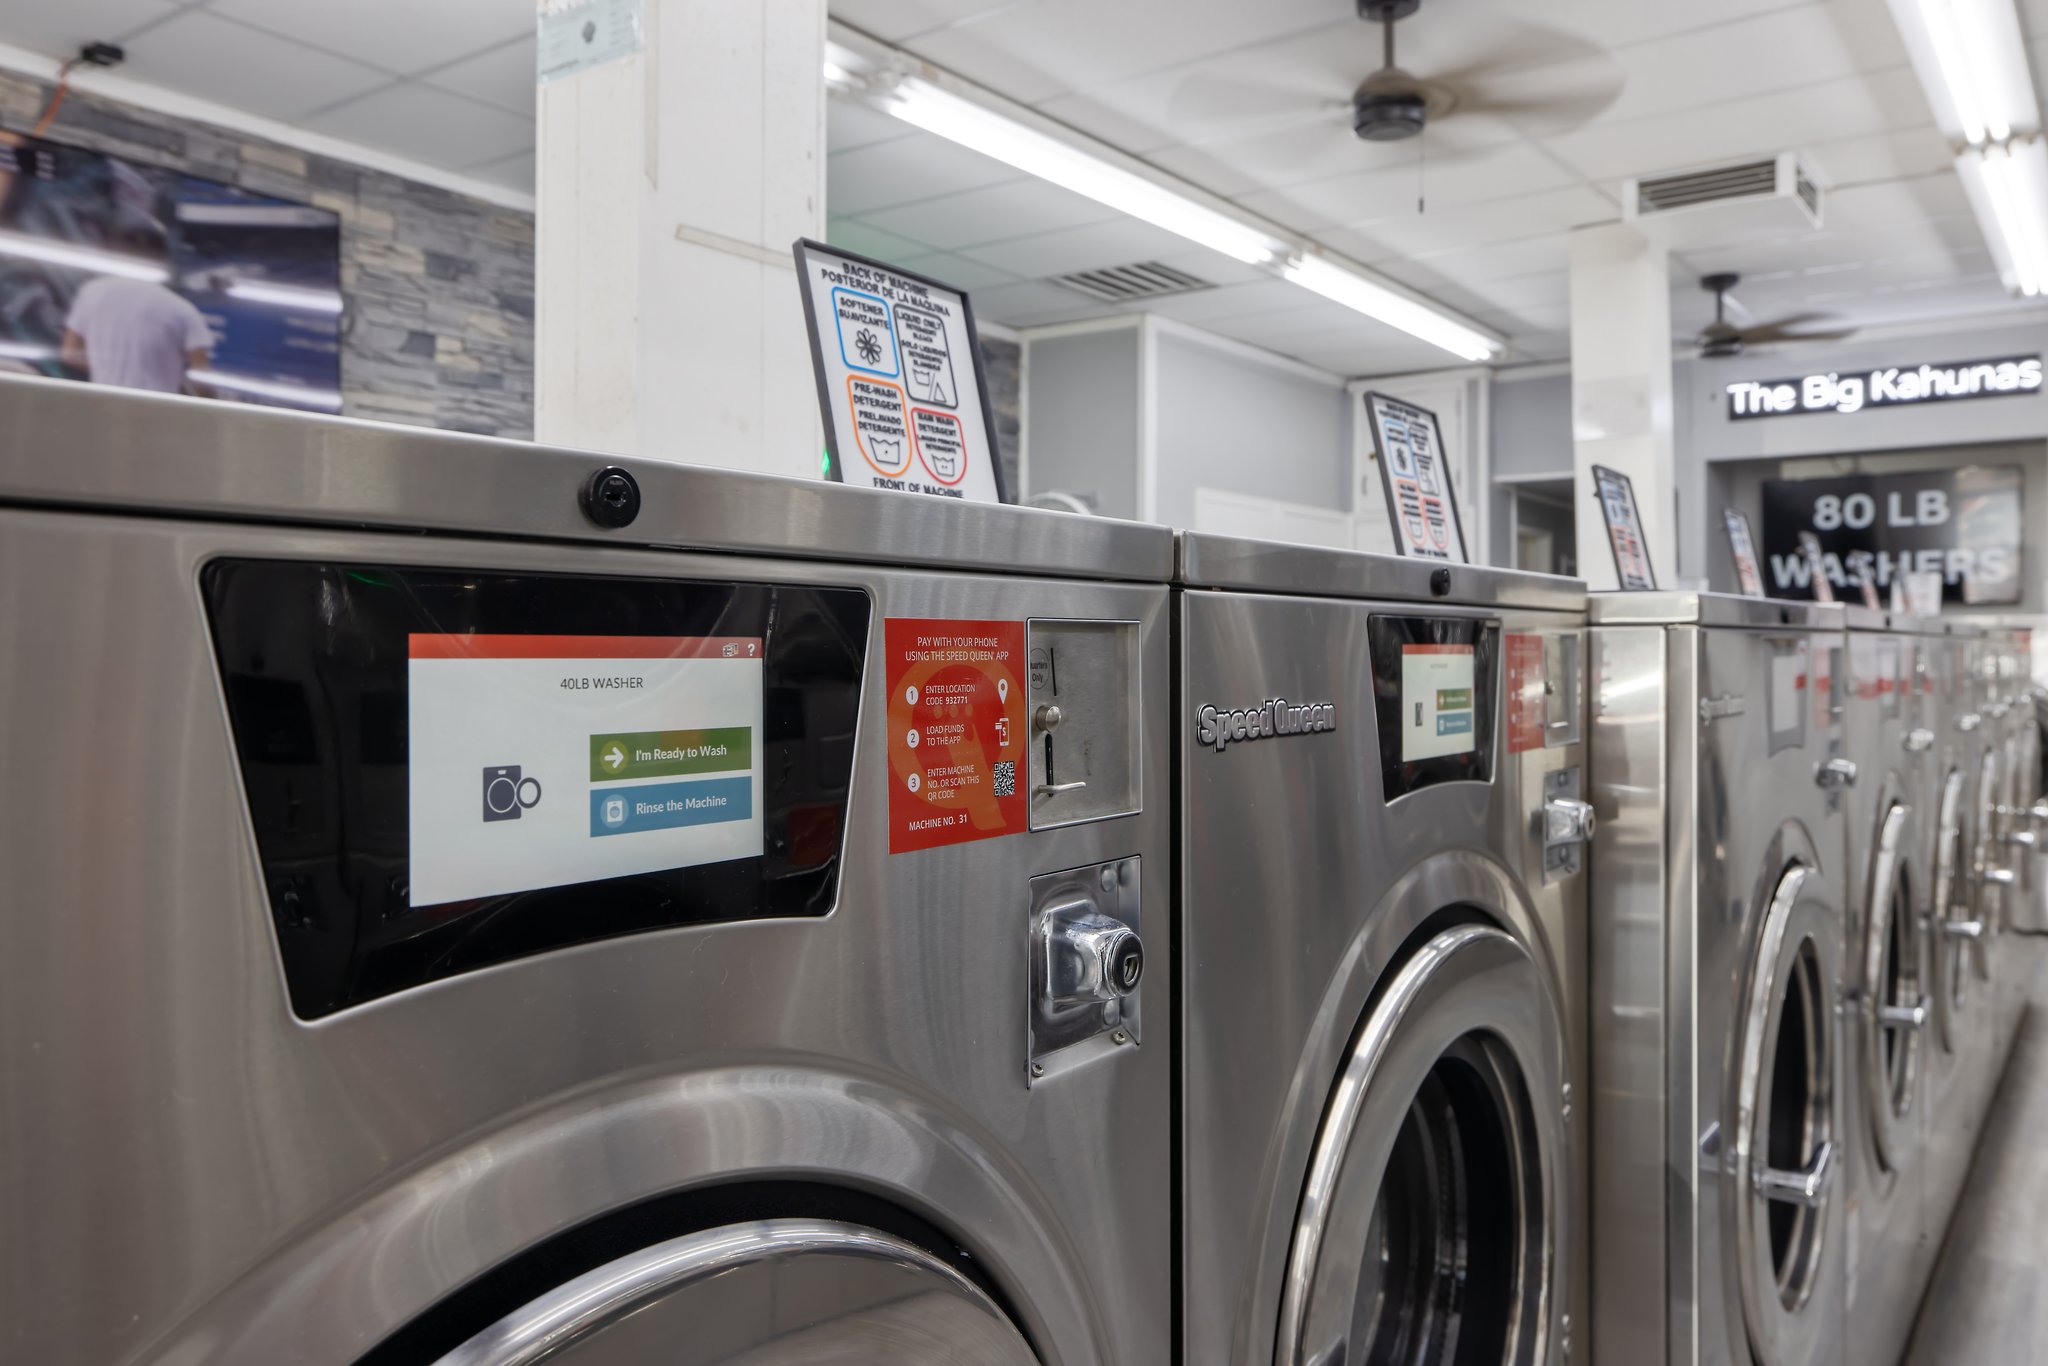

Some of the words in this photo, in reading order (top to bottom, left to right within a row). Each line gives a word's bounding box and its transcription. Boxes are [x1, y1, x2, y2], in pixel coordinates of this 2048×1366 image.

[821, 268, 879, 294] POSTERIOR
[882, 286, 895, 300] DE
[897, 290, 909, 304] LA
[843, 262, 871, 280] BACK
[874, 272, 886, 284] OF
[888, 276, 928, 299] MACHINE
[840, 297, 884, 316] SOFTENER
[838, 308, 890, 330] SUAVIZANTE
[896, 310, 922, 324] LIQUID
[854, 382, 898, 399] PRE-WASH
[1726, 380, 1796, 415] The
[1802, 372, 1864, 413] Big
[1870, 359, 2043, 402] Kahunas
[853, 394, 902, 412] DETERGENT
[858, 421, 906, 438] DETERGENTE
[918, 423, 957, 437] DETERGENT
[873, 478, 906, 492] FRONT
[908, 482, 920, 493] OF
[924, 485, 964, 498] MACHINE
[1811, 492, 1876, 531] 80
[1887, 489, 1951, 528] LB
[917, 636, 932, 647] PAY
[933, 637, 952, 647] WITH
[953, 638, 973, 647] YOUR
[974, 638, 998, 648] PHONE
[748, 643, 756, 656] ?
[905, 650, 930, 661] USING
[930, 651, 945, 660] THE
[946, 651, 968, 660] SPEED
[996, 652, 1009, 660] APP
[560, 678, 590, 690] 40LB
[593, 676, 644, 689] WASHER
[926, 685, 944, 694] ENTER
[946, 684, 976, 694] LOCATION
[926, 697, 944, 706] CODE
[946, 696, 968, 704] 932771
[926, 726, 944, 734] LOAD
[944, 724, 965, 733] FUNDS
[1196, 699, 1274, 752] Speed
[1274, 697, 1336, 736] Queen
[910, 733, 916, 743] 2
[926, 738, 936, 746] TO
[937, 736, 948, 745] THE
[950, 736, 961, 744] APP
[636, 749, 652, 761] I'm
[654, 748, 685, 762] Ready
[686, 746, 698, 758] to
[700, 744, 727, 756] Wash
[928, 768, 946, 778] ENTER
[947, 764, 975, 776] MACHINE
[911, 778, 916, 788] 3
[928, 780, 940, 789] NO.
[940, 779, 950, 788] OR
[950, 776, 966, 786] SCAN
[966, 775, 980, 784] THIS
[928, 792, 938, 802] QR
[938, 790, 956, 800] CODE
[636, 801, 664, 814] Rinse
[666, 799, 683, 812] the
[686, 796, 727, 809] Machine
[908, 816, 942, 832] MACHINE
[942, 816, 956, 826] NO.
[958, 814, 968, 824] 31
